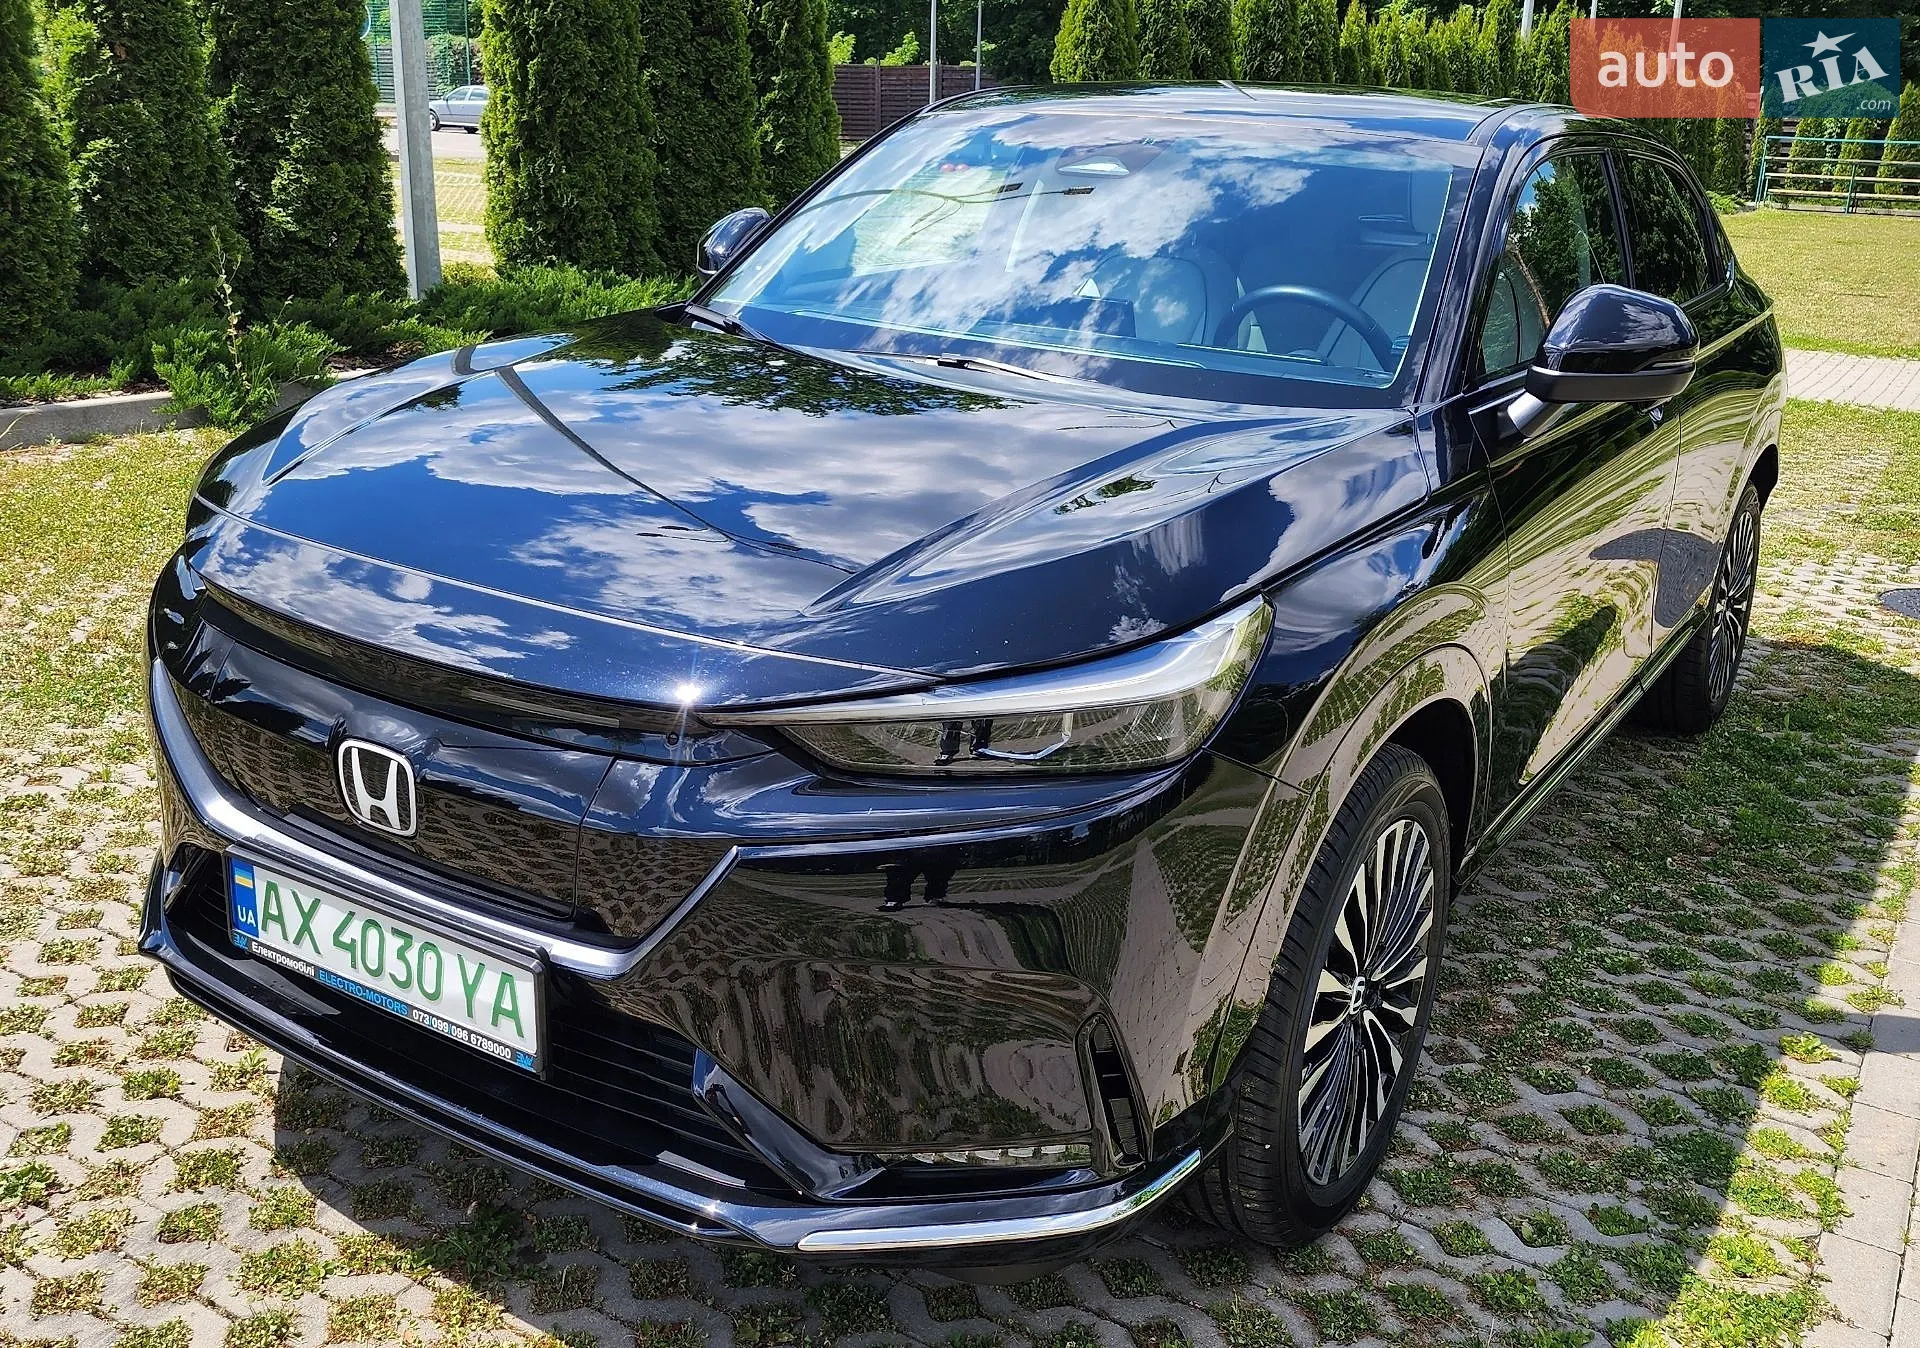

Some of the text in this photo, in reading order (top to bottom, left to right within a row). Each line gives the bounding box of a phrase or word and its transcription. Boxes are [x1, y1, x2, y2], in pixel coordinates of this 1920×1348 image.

[237, 904, 257, 928] UA
[251, 941, 315, 977] Електромобілі
[261, 879, 524, 1038] AX 4030 YA
[319, 969, 408, 1016] ELECTRO-MOTORS
[412, 1009, 512, 1060] 073/099/096 6789000
